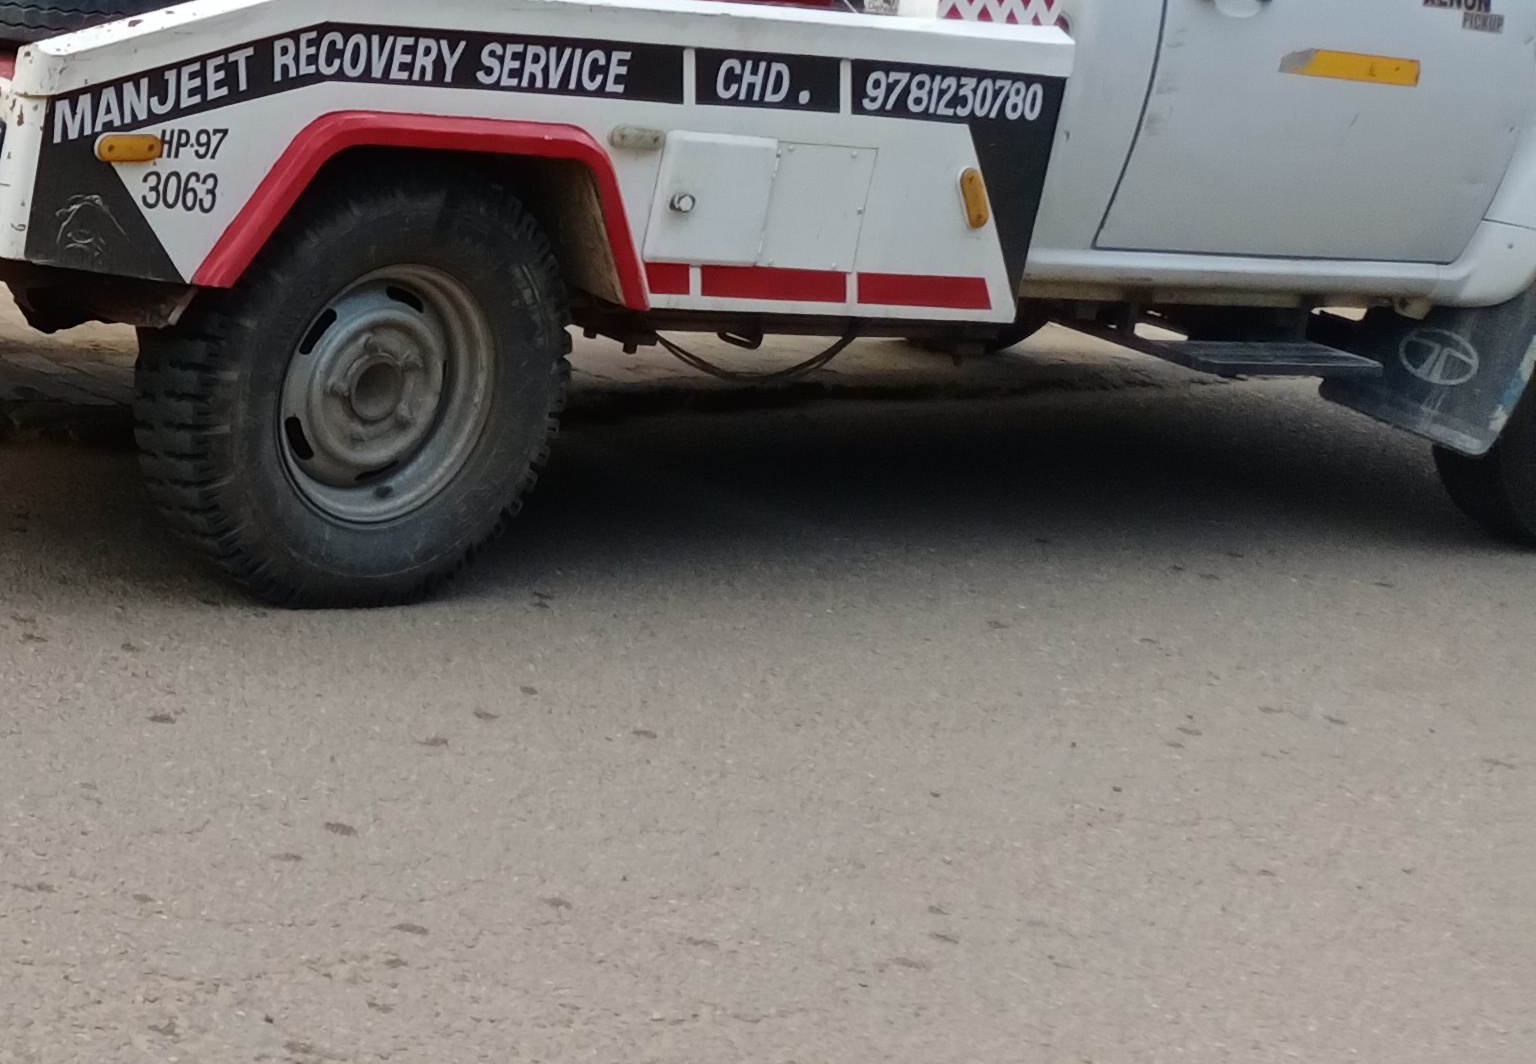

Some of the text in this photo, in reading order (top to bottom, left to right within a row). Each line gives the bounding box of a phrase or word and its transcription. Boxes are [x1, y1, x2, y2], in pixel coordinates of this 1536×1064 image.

[1461, 11, 1505, 35] PICKUP
[51, 46, 256, 145] MANJEET
[272, 29, 468, 84] RECOVERY
[476, 41, 633, 94] SERVICE
[862, 69, 1046, 122] 9781230780
[140, 170, 219, 216] 3063
